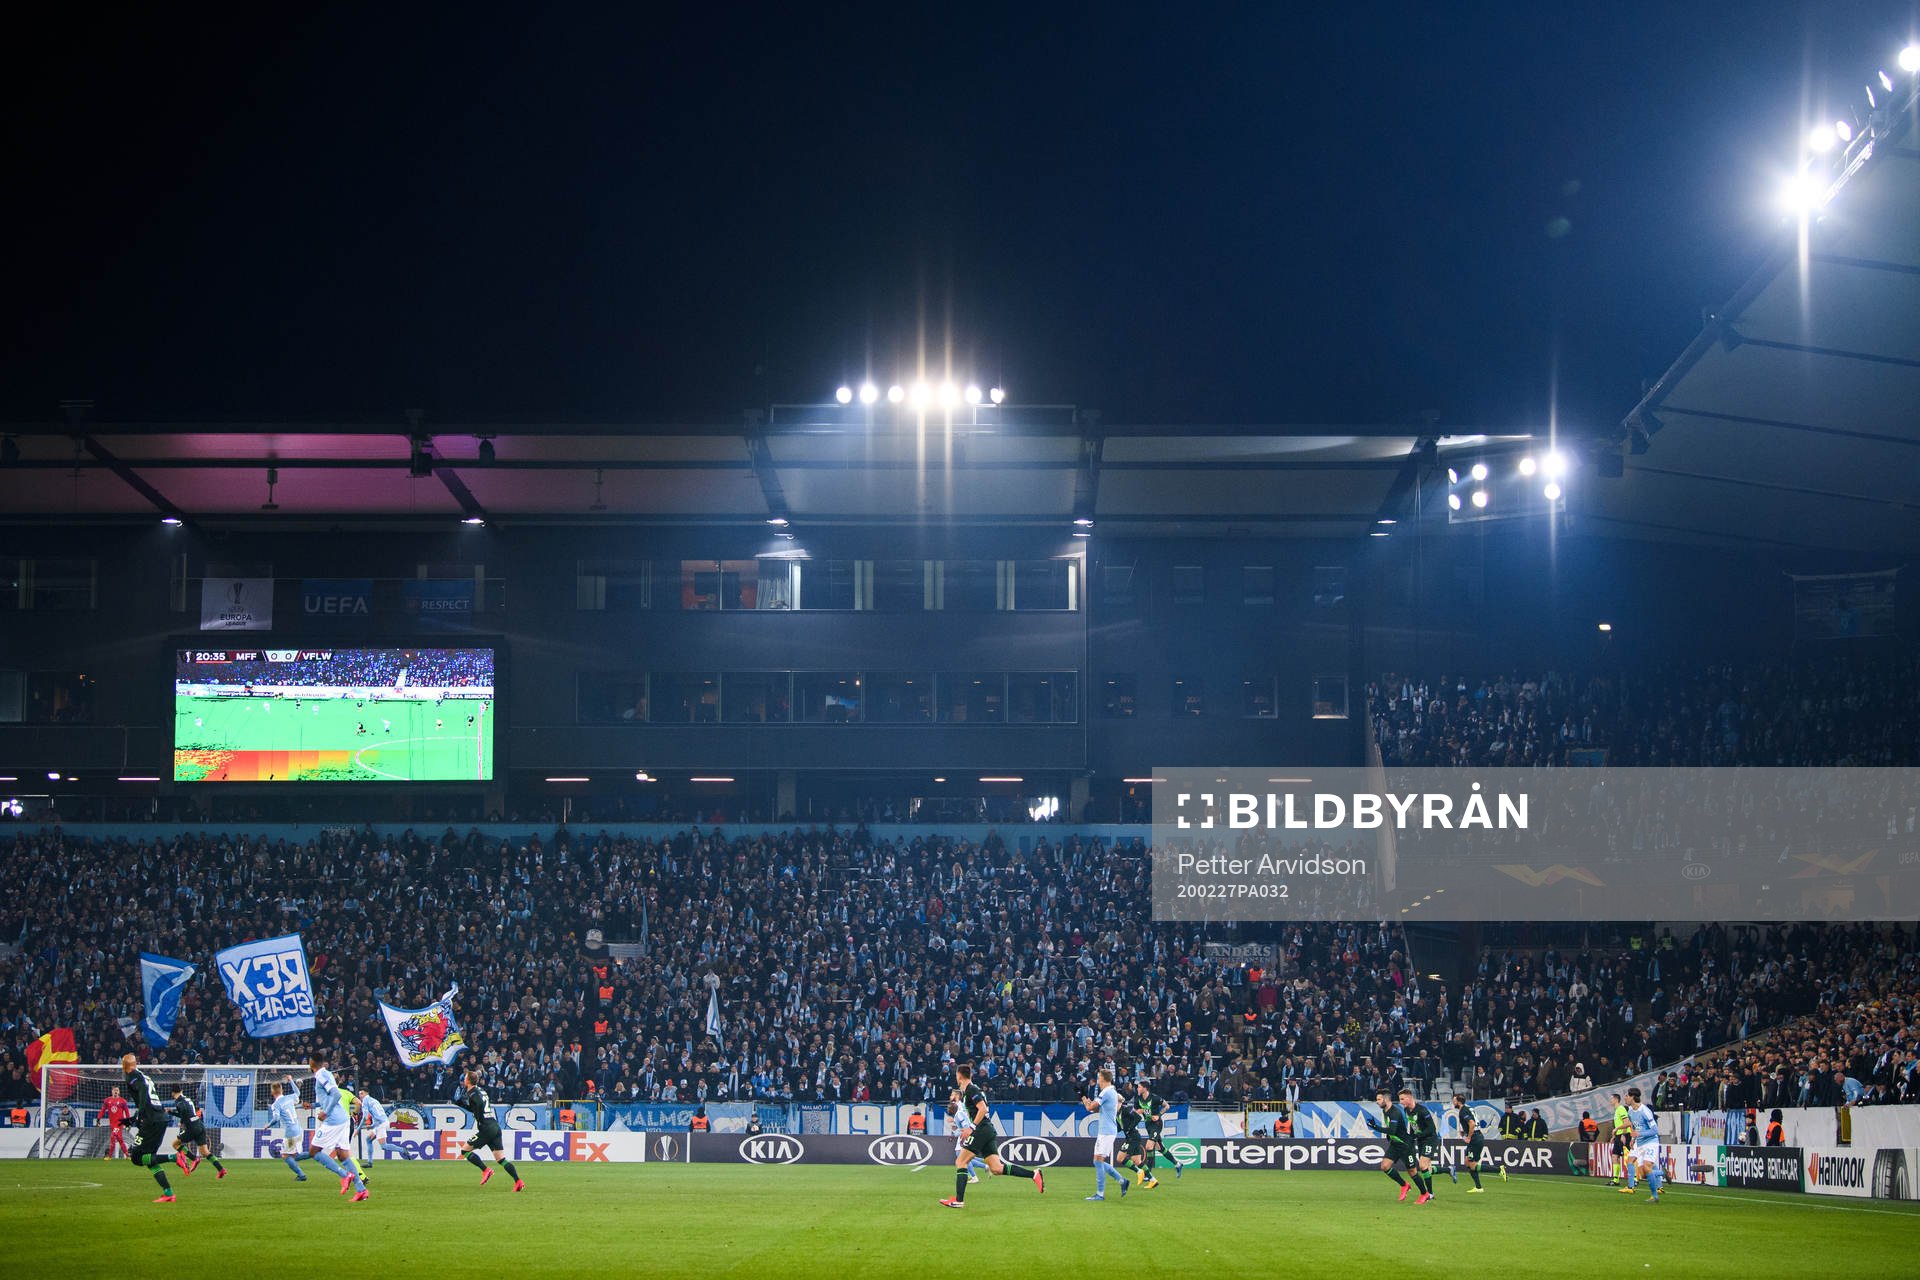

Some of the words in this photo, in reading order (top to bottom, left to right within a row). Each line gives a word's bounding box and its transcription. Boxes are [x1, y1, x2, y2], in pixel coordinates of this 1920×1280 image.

[305, 596, 369, 614] UEFA
[422, 600, 470, 610] RESPECT
[196, 653, 226, 661] 20:35
[236, 653, 257, 661] MFF
[302, 653, 332, 661] VFLW
[1210, 945, 1272, 957] ANDERS
[514, 1130, 610, 1162] FedEx
[750, 1140, 794, 1159] KIA
[879, 1141, 923, 1160] KIA
[1008, 1143, 1051, 1162] KIA
[1156, 1138, 1386, 1171] enterprise
[1408, 1155, 1414, 1163] 8
[1717, 1150, 1765, 1186] enterprise
[1767, 1158, 1799, 1181] RENT-A-CAR
